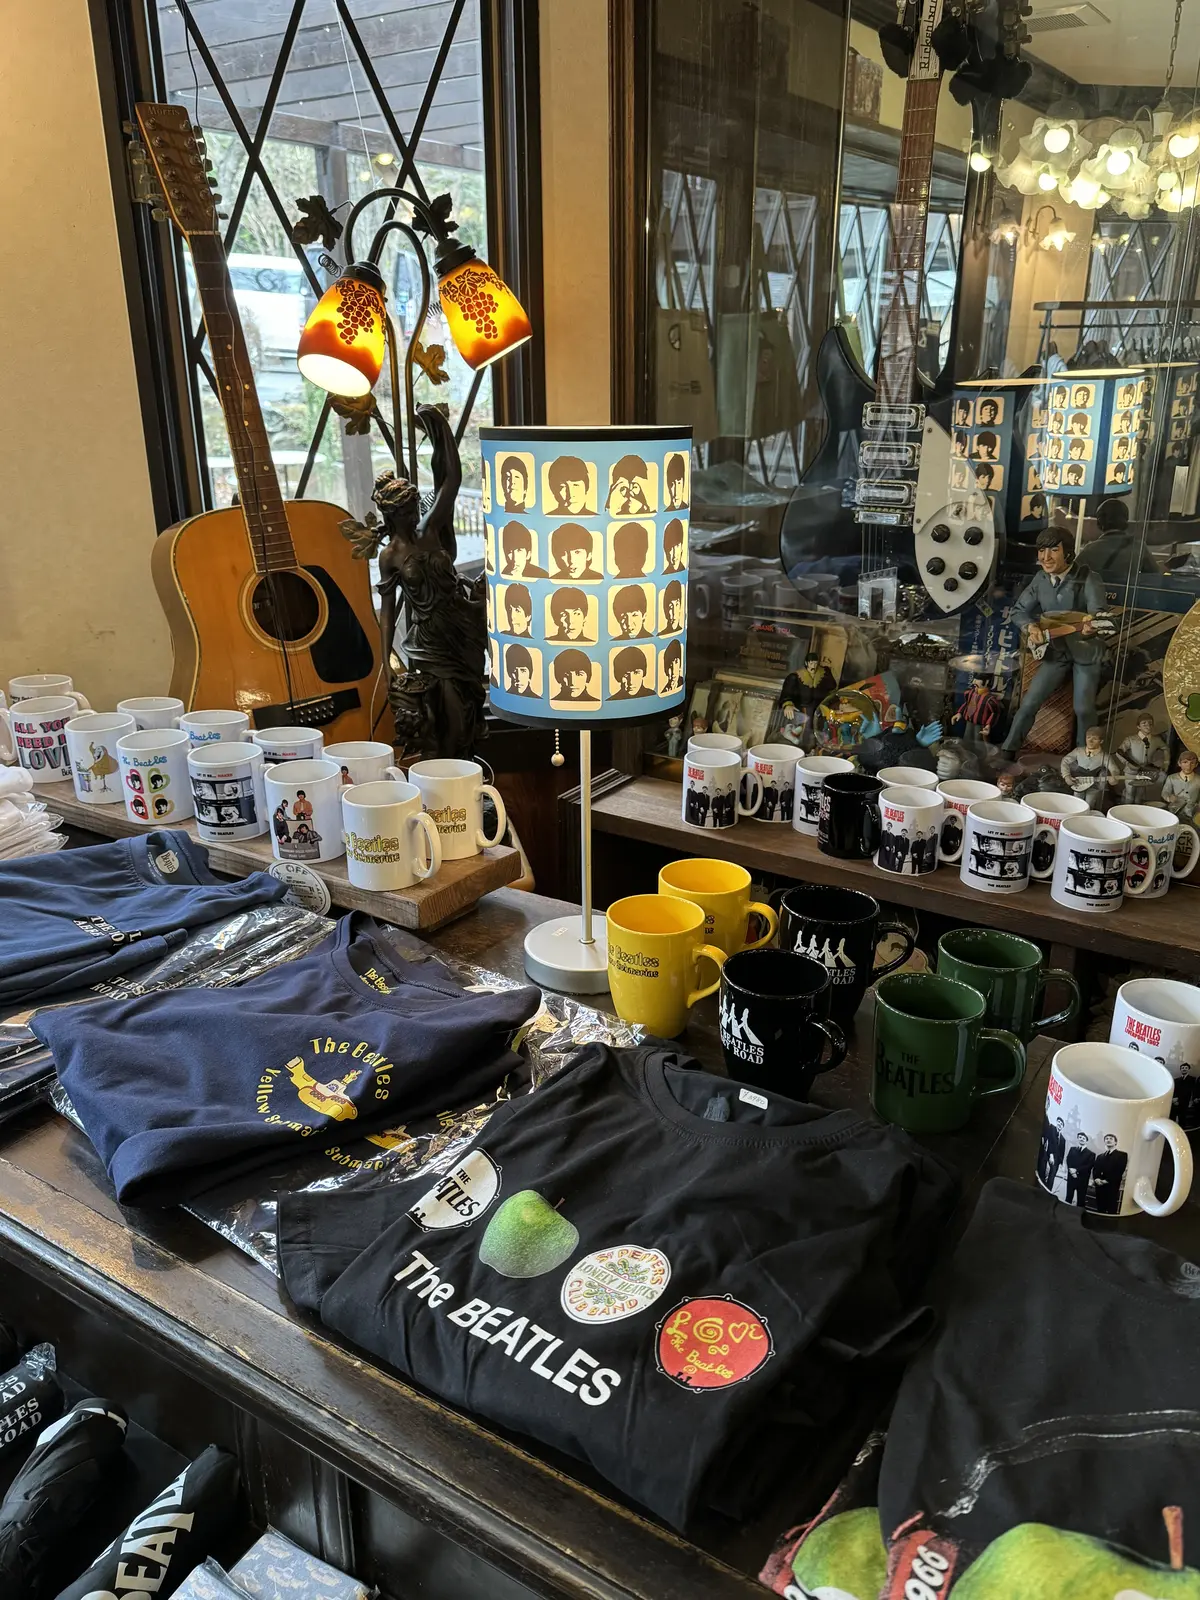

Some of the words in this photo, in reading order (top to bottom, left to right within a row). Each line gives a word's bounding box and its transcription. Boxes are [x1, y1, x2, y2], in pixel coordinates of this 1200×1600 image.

[147, 106, 181, 116] Morris
[14, 721, 37, 735] ALL
[189, 731, 222, 741] Beatles
[16, 735, 54, 749] NEED
[133, 755, 168, 767] Beatles
[285, 864, 309, 876] OFF
[832, 976, 855, 985] OAD
[89, 982, 129, 1001] ROAD
[1125, 1015, 1135, 1033] THE
[1135, 1020, 1162, 1041] BEATLES
[309, 1036, 350, 1055] The
[733, 1046, 764, 1065] ROAD
[901, 1051, 920, 1066] THE
[875, 1038, 954, 1099] BEATLES
[255, 1066, 282, 1115] Yellow
[456, 1168, 472, 1185] THE
[576, 1261, 619, 1285] LONELY
[616, 1281, 659, 1301] HEARTS
[568, 1278, 589, 1313] CLUB
[586, 1298, 639, 1316] BAND
[393, 1249, 455, 1309] The
[446, 1297, 622, 1406] BEATLES
[686, 1349, 735, 1379] Beatles
